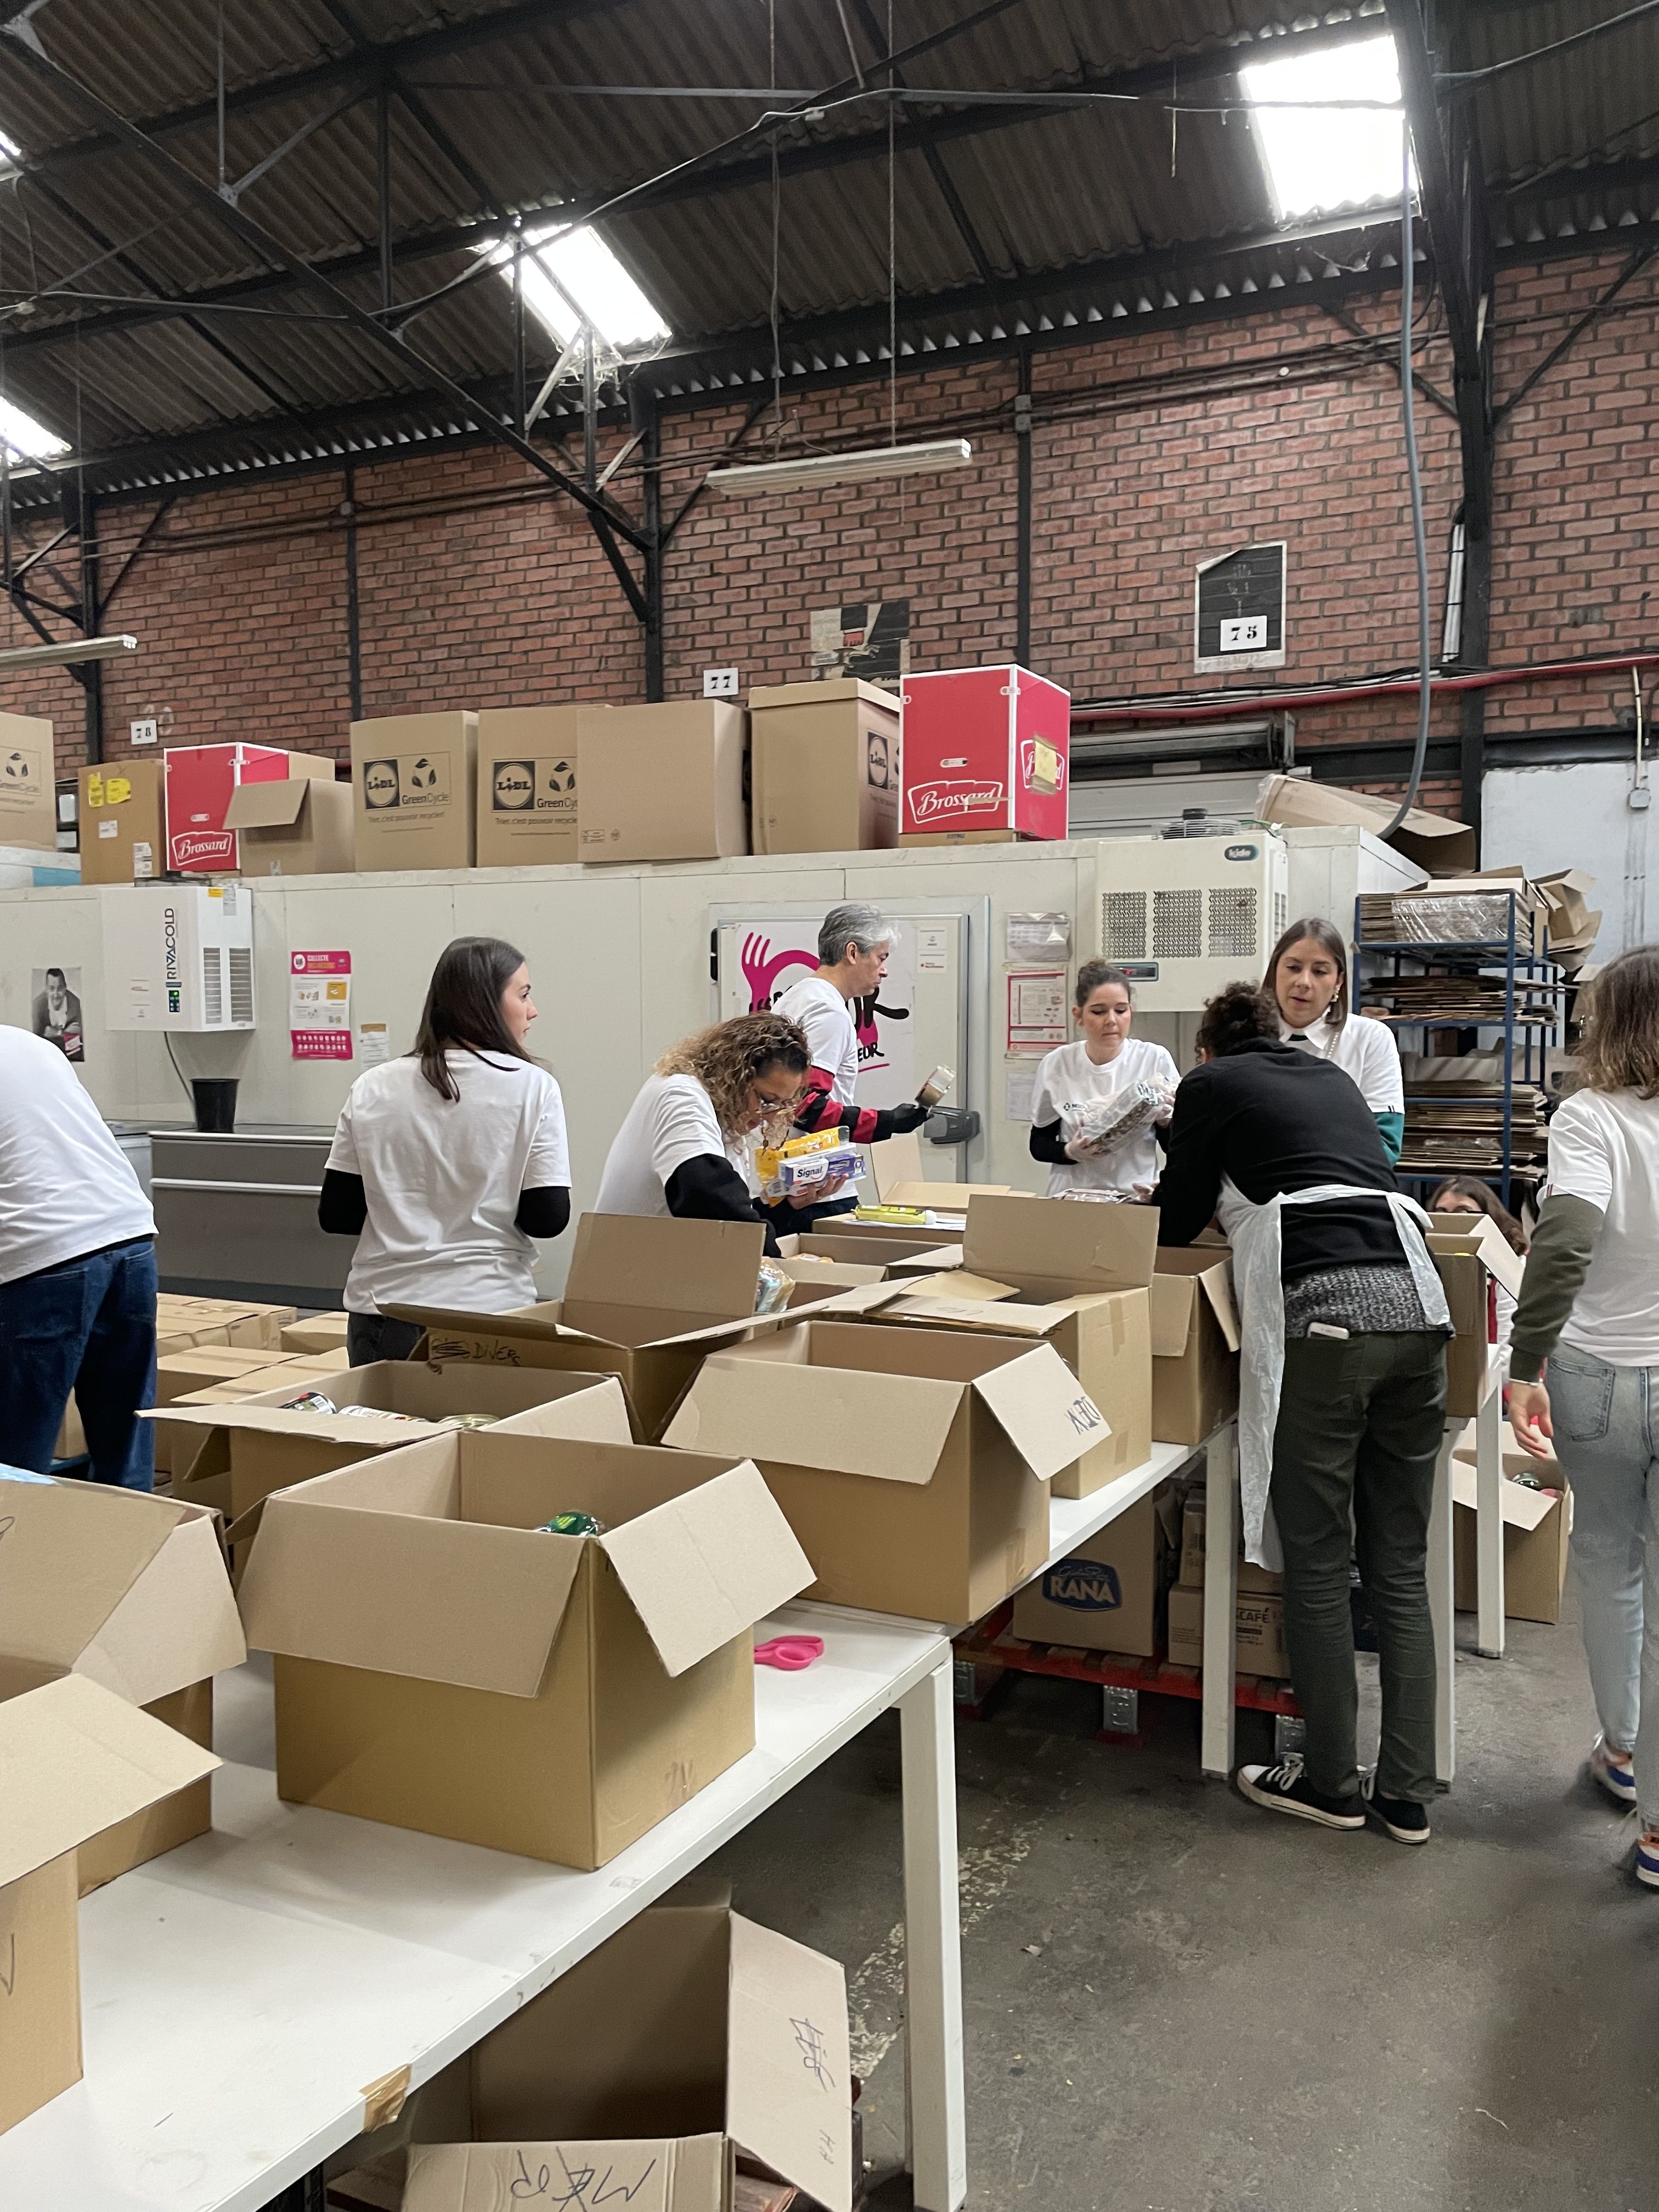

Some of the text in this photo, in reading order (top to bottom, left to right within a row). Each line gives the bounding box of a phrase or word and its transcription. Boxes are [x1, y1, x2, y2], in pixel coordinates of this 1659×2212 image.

[1231, 625, 1257, 641] 75
[710, 675, 731, 689] 77
[177, 837, 228, 860] Brossard
[165, 908, 177, 980] RIVACOLD
[857, 1041, 885, 1063] EUR
[797, 1166, 823, 1178] Signal
[1050, 1575, 1116, 1604] RANA
[1236, 1607, 1271, 1623] CAFÉ
